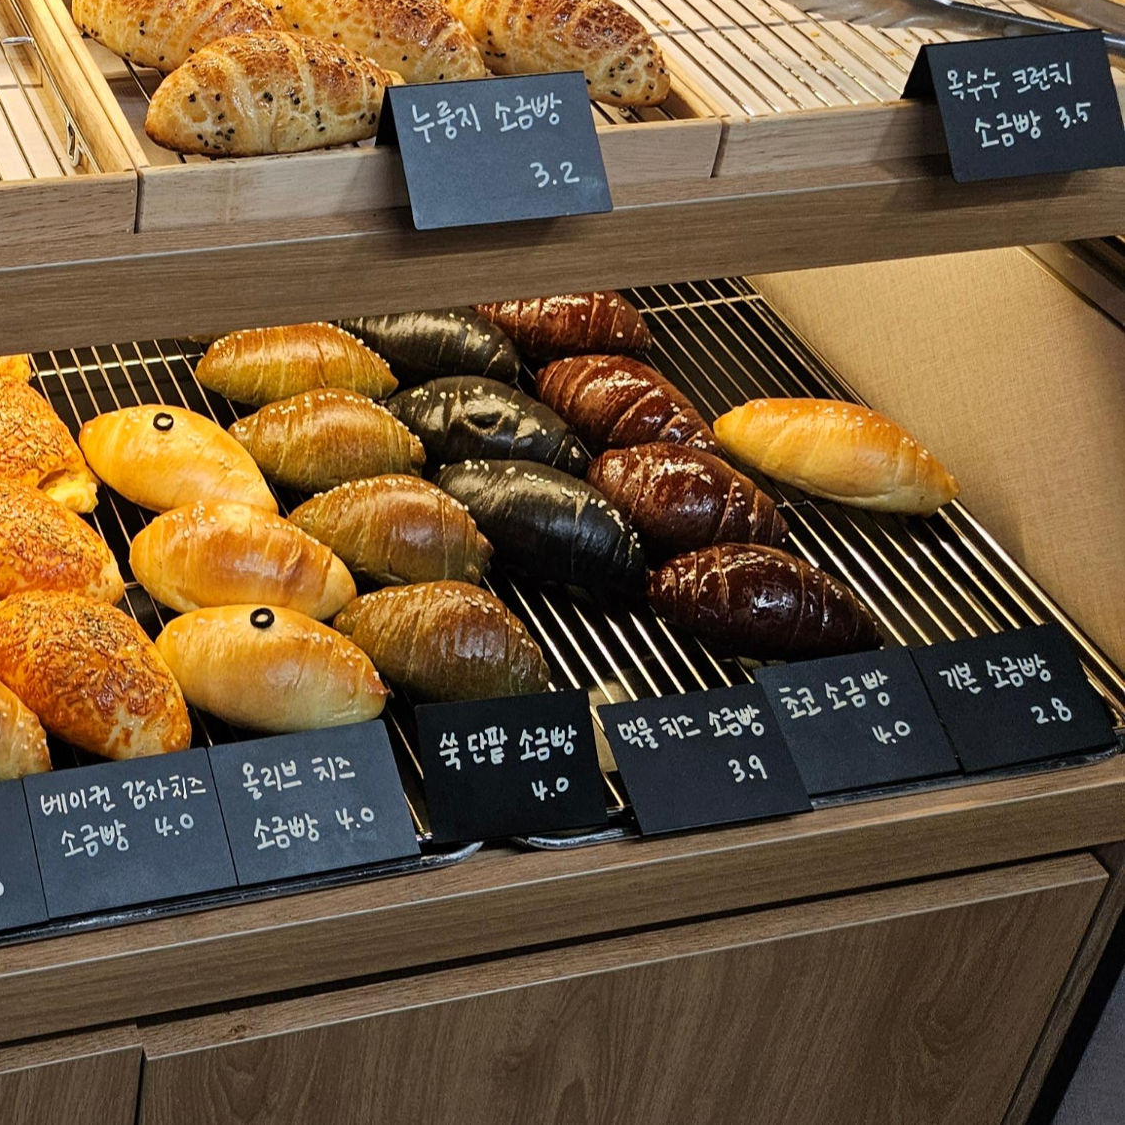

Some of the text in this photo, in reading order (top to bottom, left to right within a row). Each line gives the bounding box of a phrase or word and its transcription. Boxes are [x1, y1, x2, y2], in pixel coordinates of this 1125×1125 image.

[947, 62, 1072, 102] 옥수수 크런치
[411, 92, 562, 143] 누룽지 소금빵
[975, 102, 1092, 148] 소금빵 3.5
[530, 161, 580, 188] 3.2
[778, 669, 891, 720] 초코 소금빵
[938, 653, 1052, 694] 기본 소금빵
[617, 704, 765, 750] 먹물 치즈 소금빵
[1030, 697, 1073, 724] 2.8
[439, 724, 578, 771] 쑥 단팥 소금빵
[871, 720, 911, 745] 4.0
[242, 756, 356, 801] 올리브 치즈
[531, 776, 569, 801] 4.0
[728, 754, 768, 783] 3.9
[40, 785, 116, 816] 베이컨
[61, 813, 194, 858] 소금빵 4.0
[253, 807, 375, 851] 소금빵 4.0
